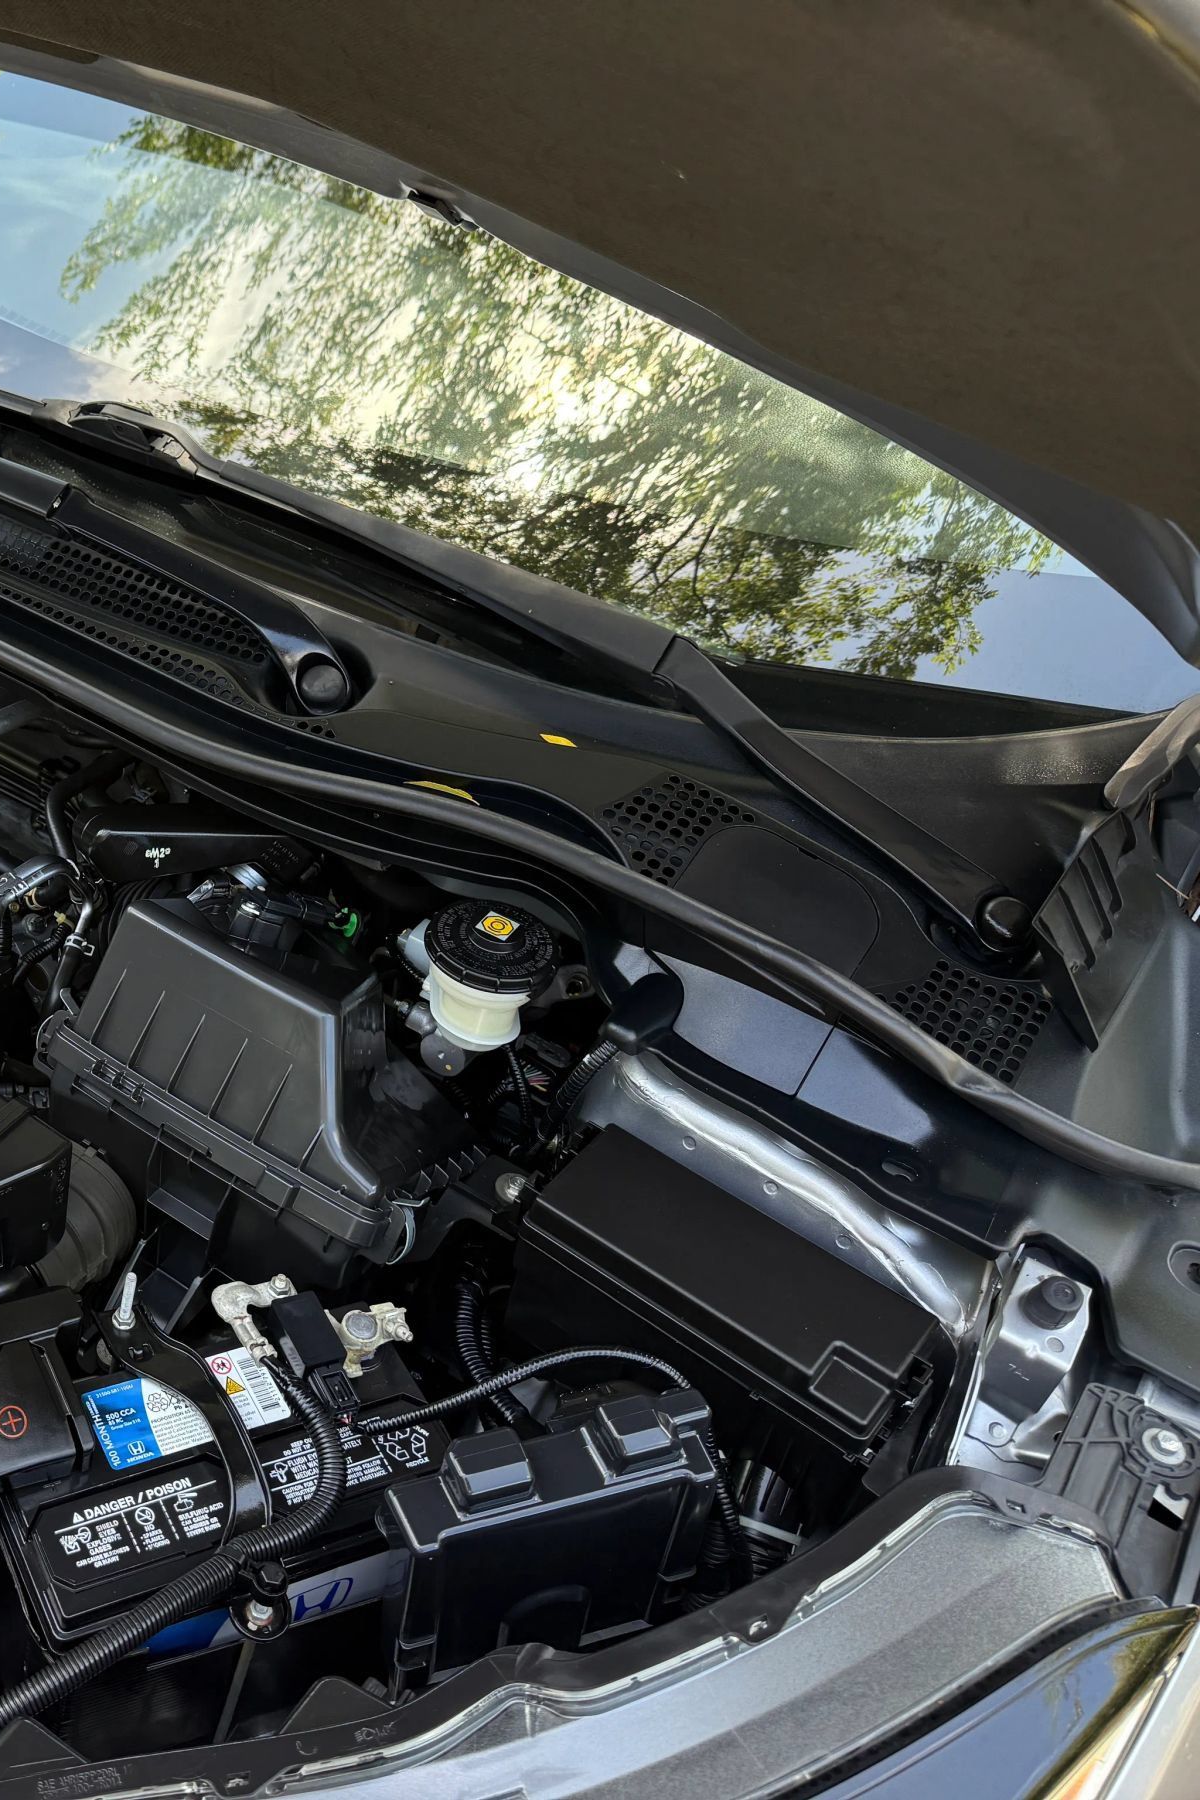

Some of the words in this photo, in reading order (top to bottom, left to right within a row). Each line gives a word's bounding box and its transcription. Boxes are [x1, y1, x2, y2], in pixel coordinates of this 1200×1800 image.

[105, 1411, 120, 1421] 500
[120, 1407, 136, 1417] CCA
[92, 1414, 114, 1450] MONTH
[109, 1449, 122, 1467] 100
[126, 1451, 155, 1463] HONDA
[287, 1456, 307, 1467] FLUSH
[406, 1456, 430, 1469] RECYCLE
[291, 1464, 307, 1473] WITH
[84, 1496, 136, 1520] DANGER
[137, 1492, 144, 1503] /
[145, 1477, 192, 1500] POISON
[178, 1507, 209, 1521] SULFURIC
[209, 1502, 224, 1511] ACID
[96, 1520, 119, 1532] SHIELD
[144, 1524, 155, 1532] NO
[98, 1528, 116, 1538] EYES
